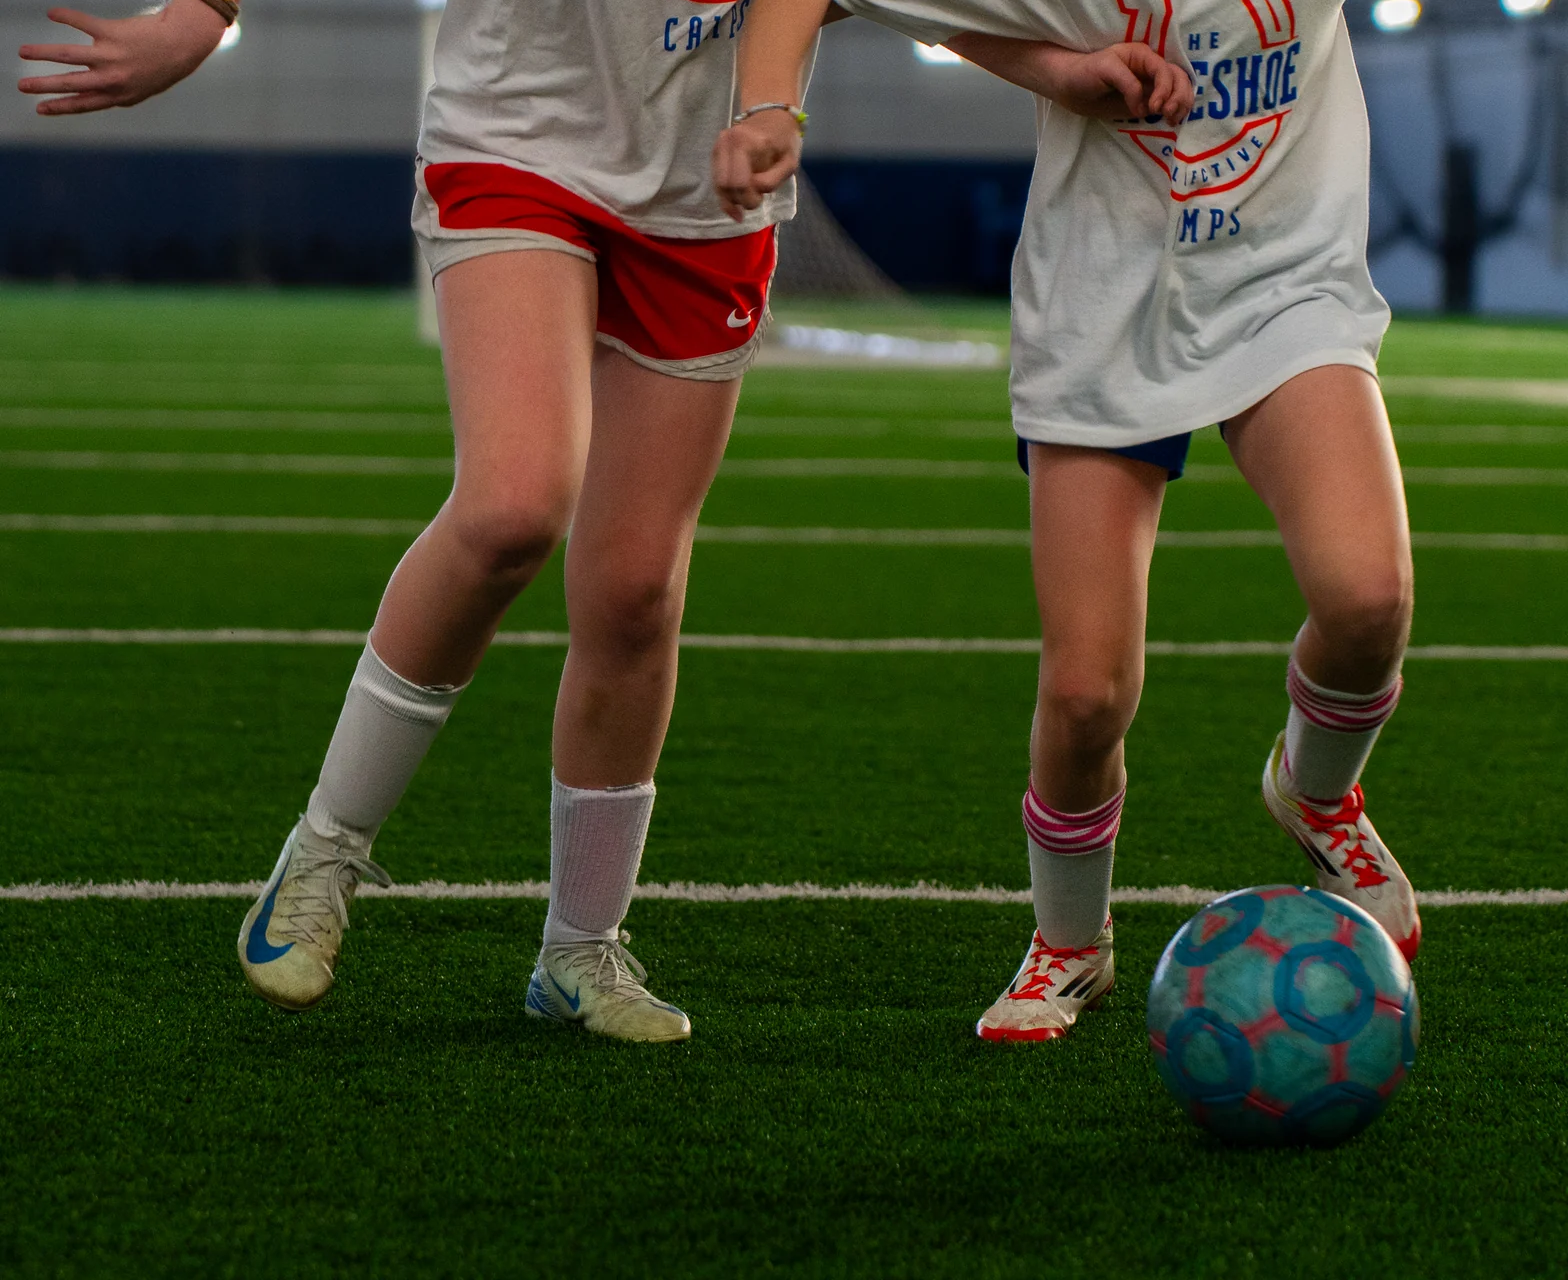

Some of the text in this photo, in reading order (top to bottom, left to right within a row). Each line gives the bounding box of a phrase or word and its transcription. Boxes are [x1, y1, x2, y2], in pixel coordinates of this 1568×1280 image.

[1189, 32, 1220, 50] HE
[1112, 42, 1301, 124] ESHOE
[1177, 206, 1241, 243] MPS
